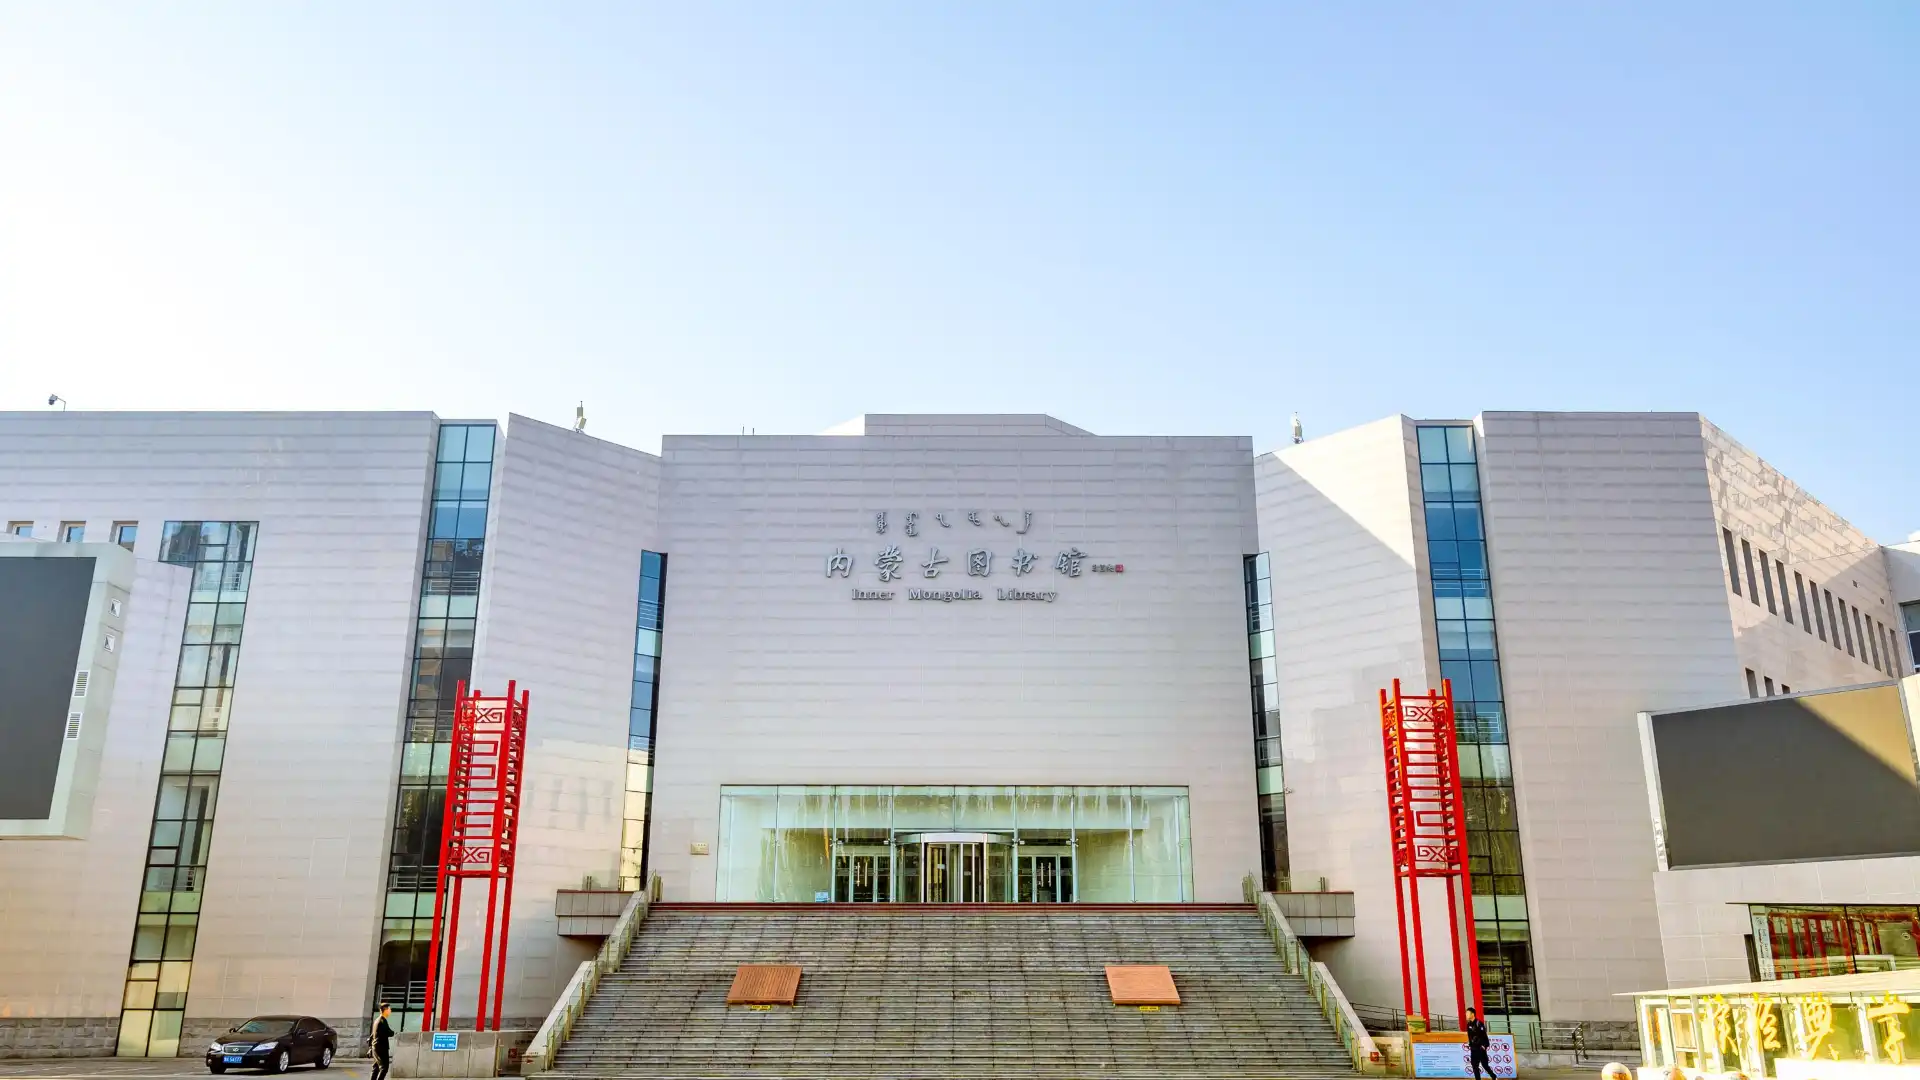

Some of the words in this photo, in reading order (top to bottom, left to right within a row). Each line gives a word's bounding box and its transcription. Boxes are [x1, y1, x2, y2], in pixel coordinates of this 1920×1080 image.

[826, 544, 1088, 582] 内蒙古图书馆
[852, 588, 896, 601] Inner
[908, 588, 982, 603] Mongolia
[997, 588, 1057, 603] Library
